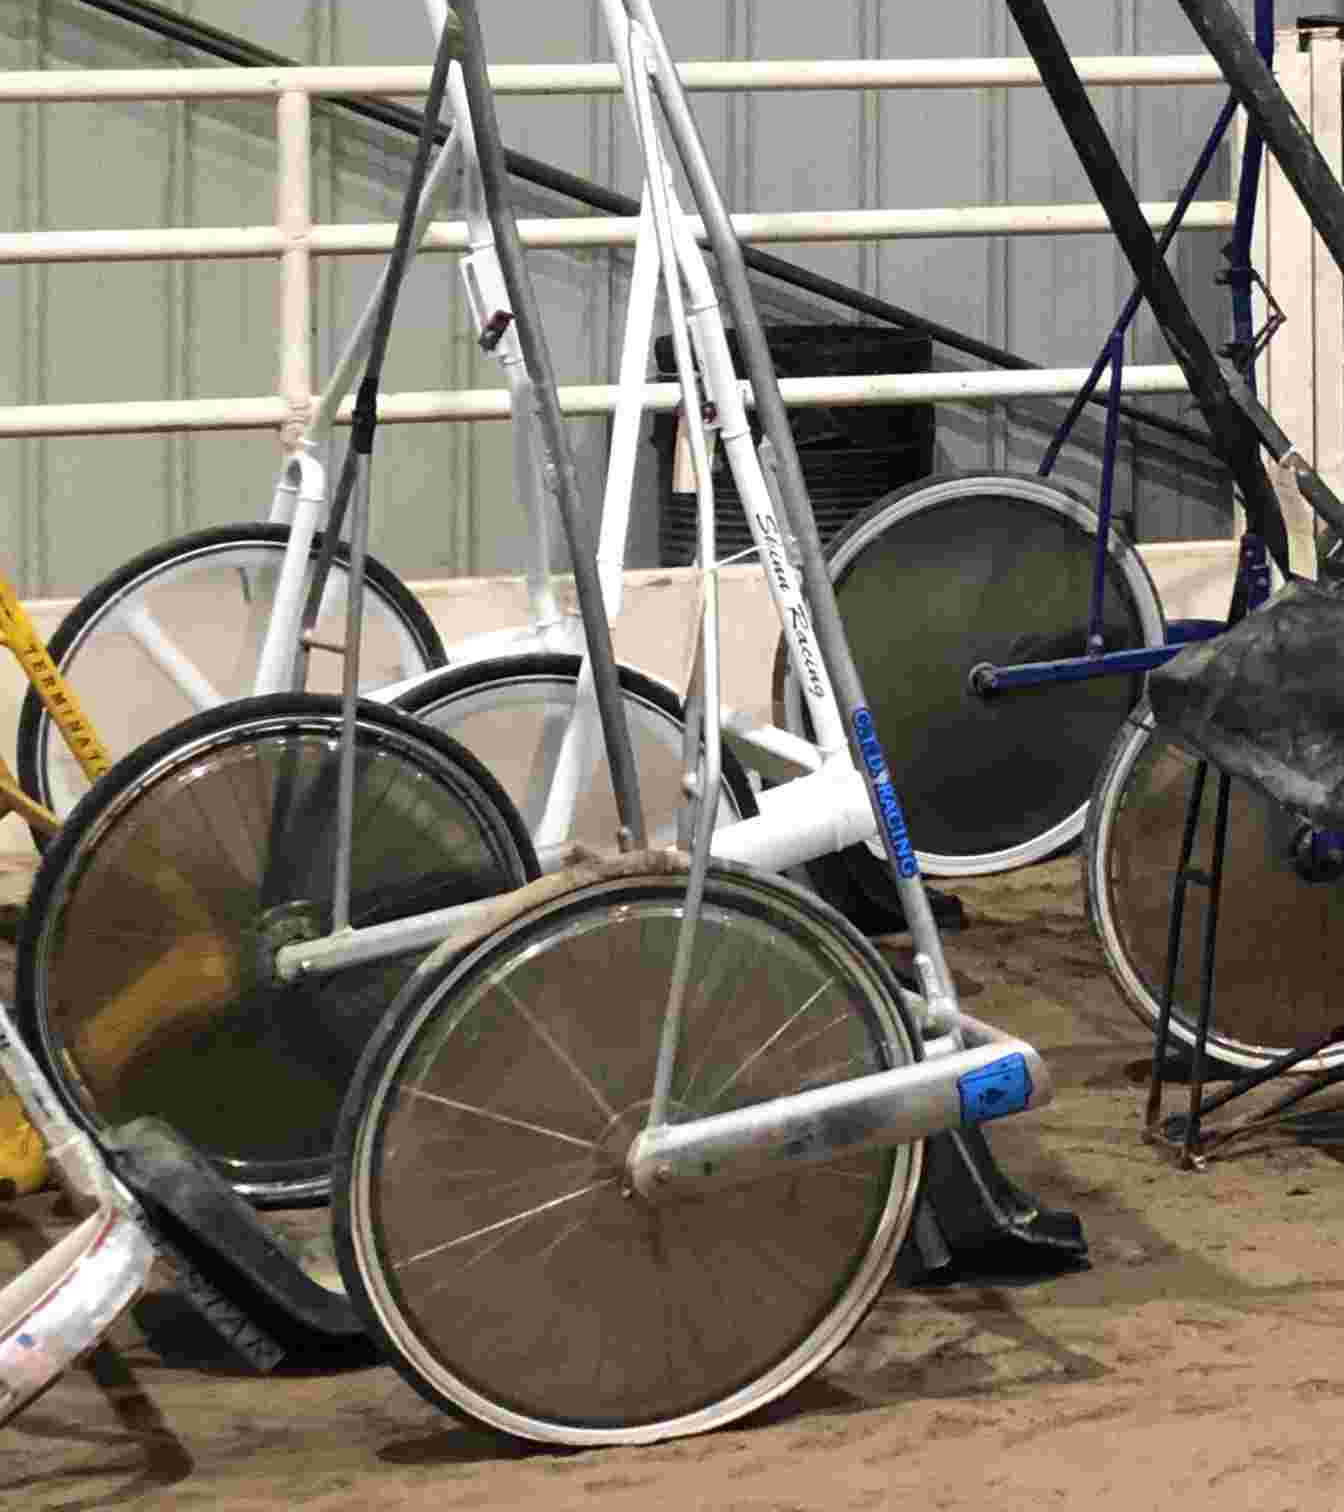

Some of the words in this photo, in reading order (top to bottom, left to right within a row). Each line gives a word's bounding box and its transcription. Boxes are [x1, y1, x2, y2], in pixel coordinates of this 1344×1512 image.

[756, 513, 791, 593] Shinn
[790, 603, 826, 698] Racing
[24, 641, 111, 774] TERMINATO
[880, 781, 918, 877] RACING
